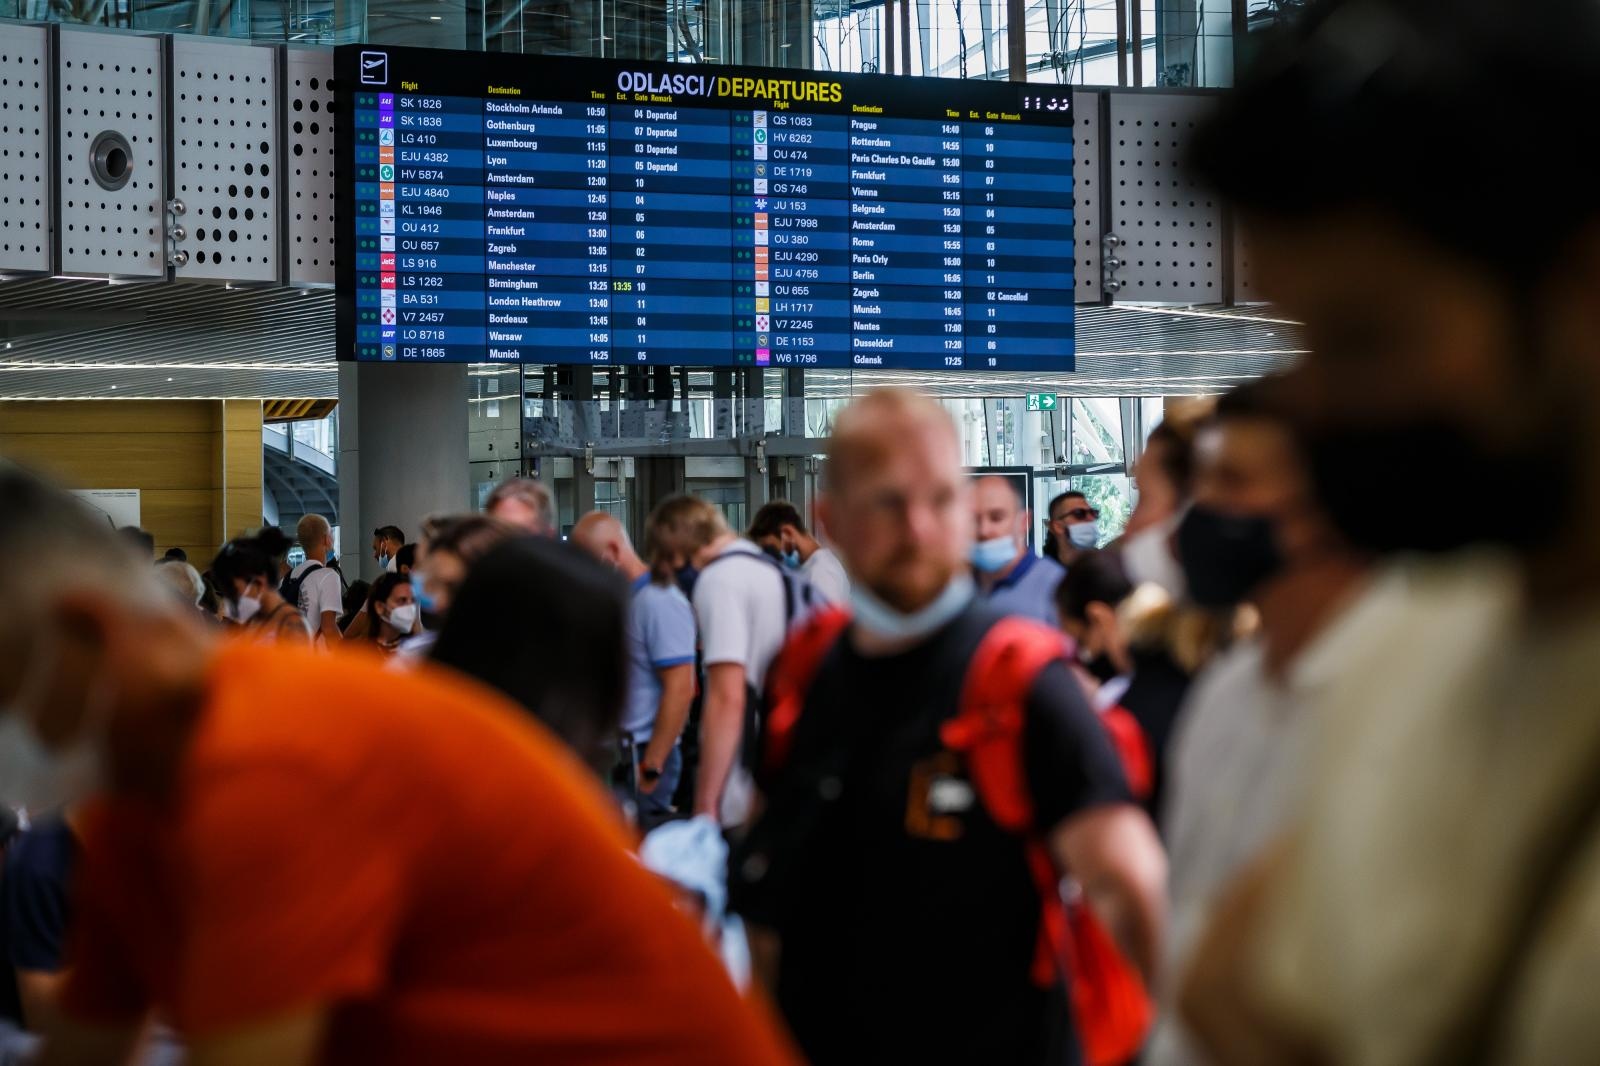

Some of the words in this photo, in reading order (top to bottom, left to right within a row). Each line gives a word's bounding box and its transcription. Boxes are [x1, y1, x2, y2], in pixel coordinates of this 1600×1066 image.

[401, 81, 418, 91] Flight
[488, 85, 521, 95] Destination
[591, 90, 605, 99] Time
[634, 93, 648, 102] Gate
[650, 94, 673, 103] Remark
[400, 97, 415, 108] SK
[417, 99, 442, 109] 1826
[486, 102, 530, 113] Stockholm
[531, 104, 563, 115] Arlanda
[586, 107, 606, 117] 10:50
[634, 109, 644, 119] 04
[646, 109, 677, 121] Departed
[773, 100, 790, 110] Flight
[852, 104, 883, 113] Destination
[946, 109, 960, 117] Time
[986, 111, 999, 120] Gate
[1000, 112, 1021, 121] Remark
[401, 115, 415, 126] SK
[417, 116, 442, 127] 1836
[486, 119, 535, 133] Gothenburg
[586, 124, 606, 134] 11:05
[634, 126, 644, 136] 07
[646, 127, 678, 139] Departed
[773, 115, 787, 125] QS
[851, 119, 877, 131] Prague
[401, 133, 414, 143] LG
[417, 134, 437, 144] 410
[486, 137, 538, 151] Luxembourg
[587, 141, 606, 152] 11:15
[635, 143, 644, 153] 03
[646, 144, 678, 156] Departed
[773, 133, 788, 142] HV
[851, 136, 891, 147] Rotterdam
[401, 151, 421, 161] EJU
[423, 152, 449, 163] 4382
[487, 155, 507, 167] Lyon
[587, 159, 606, 169] 11:20
[635, 161, 644, 170] 05
[646, 161, 678, 173] Departed
[773, 149, 788, 159] OU
[790, 150, 808, 160] 474
[851, 153, 870, 163] Paris
[871, 153, 900, 165] Charles
[900, 155, 911, 165] De
[911, 156, 936, 166] Gaulle
[401, 169, 416, 179] HV
[418, 170, 444, 180] 5874
[487, 172, 534, 184] Amsterdam
[587, 176, 607, 186] 12:00
[635, 178, 644, 188] 10
[774, 166, 787, 176] DE
[851, 170, 886, 181] Frankfurt
[401, 187, 421, 197] EJU
[423, 188, 450, 198] 4840
[487, 190, 516, 202] Naples
[587, 194, 607, 204] 12:45
[635, 195, 644, 205] 04
[773, 183, 788, 193] OS
[851, 186, 878, 197] Vienna
[402, 205, 415, 215] KL
[417, 205, 442, 216] 1946
[487, 207, 535, 219] Amsterdam
[587, 211, 607, 221] 12:50
[635, 212, 645, 222] 05
[773, 201, 787, 210] JU
[789, 201, 807, 211] 153
[852, 203, 885, 215] Belgrade
[401, 222, 418, 232] OU
[420, 223, 439, 233] 412
[487, 225, 525, 236] Frankfurt
[588, 228, 607, 238] 13:00
[635, 230, 645, 240] 06
[774, 217, 792, 227] EJU
[795, 218, 818, 228] 7998
[852, 220, 896, 231] Amsterdam
[774, 234, 789, 244] OU
[791, 235, 809, 245] 380
[852, 237, 875, 247] Rome
[402, 240, 418, 250] OU
[420, 241, 440, 251] 657
[488, 243, 517, 255] Zagreb
[588, 246, 607, 256] 13:05
[636, 247, 645, 257] 02
[402, 258, 415, 268] LS
[417, 258, 437, 269] 916
[488, 260, 536, 271] Manchester
[588, 263, 608, 273] 13:15
[636, 264, 645, 274] 07
[774, 251, 793, 261] EJU
[794, 252, 819, 262] 4290
[852, 253, 871, 263] Paris
[872, 254, 889, 266] Orly
[775, 268, 793, 278] EJU
[795, 269, 819, 279] 4756
[852, 270, 875, 280] Berlin
[403, 276, 416, 286] LS
[418, 277, 443, 287] 1262
[489, 278, 538, 290] Birmingham
[589, 281, 608, 291] 13:25
[613, 281, 632, 291] 13:35
[637, 282, 646, 292] 10
[775, 285, 790, 295] OU
[852, 287, 880, 299] Zagreb
[997, 291, 1028, 301] Cancelled
[403, 294, 418, 304] BA
[420, 294, 438, 304] 531
[489, 296, 520, 306] London
[521, 296, 561, 307] Heathrow
[589, 298, 608, 308] 13:40
[637, 299, 645, 309] 11
[775, 303, 788, 312] LH
[790, 303, 813, 312] 1717
[853, 304, 881, 314] Munich
[402, 312, 416, 321] V7
[419, 312, 444, 322] 2457
[489, 313, 528, 324] Bordeaux
[589, 315, 608, 325] 13:45
[637, 316, 646, 326] 04
[775, 319, 788, 329] V7
[790, 320, 813, 329] 2245
[853, 321, 880, 331] Nantes
[403, 329, 417, 340] LO
[419, 330, 445, 340] 8718
[489, 331, 523, 341] Warsaw
[589, 333, 609, 343] 14:05
[637, 334, 646, 343] 11
[776, 336, 789, 346] DE
[791, 337, 814, 346] 1153
[853, 338, 894, 348] Dusseldorf
[403, 347, 417, 357] DE
[421, 348, 445, 358] 1865
[489, 349, 520, 359] Munich
[589, 350, 609, 360] 14:25
[637, 351, 647, 361] 05
[775, 353, 792, 363] W6
[794, 354, 817, 363] 1796
[853, 354, 882, 365] Gdansk
